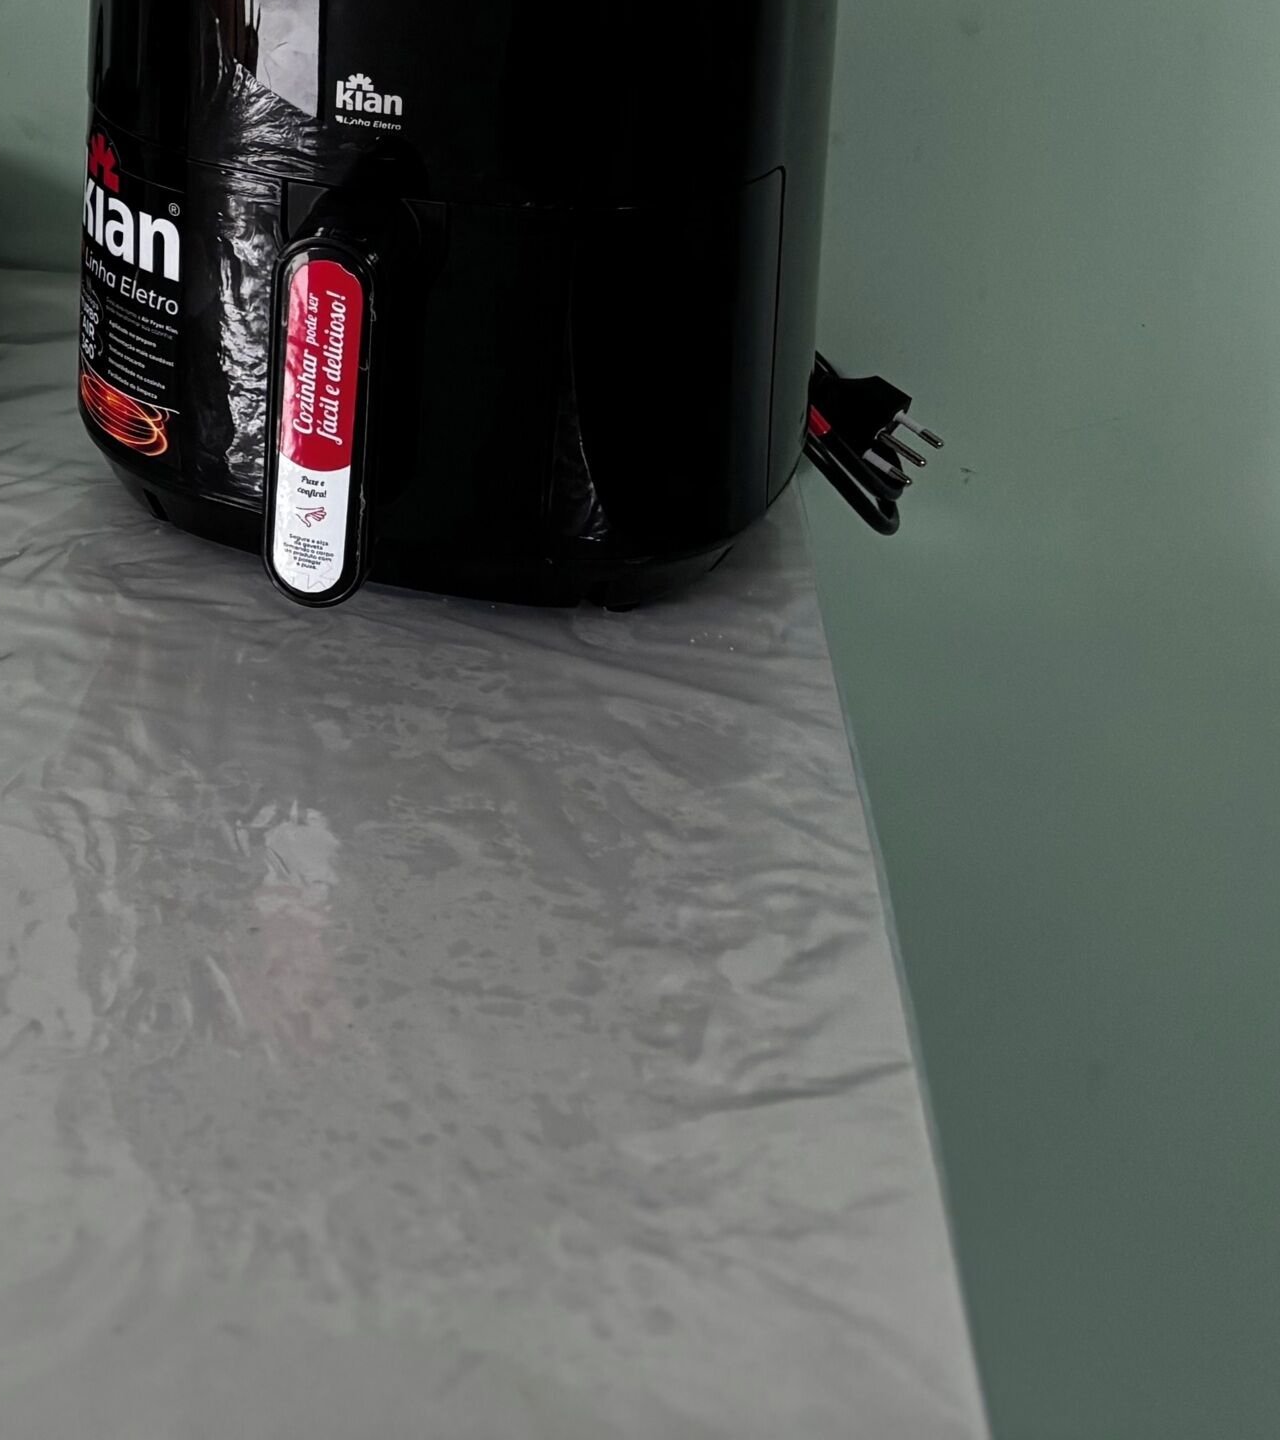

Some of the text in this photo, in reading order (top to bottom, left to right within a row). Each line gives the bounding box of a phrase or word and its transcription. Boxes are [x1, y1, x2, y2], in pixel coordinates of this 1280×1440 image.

[344, 117, 402, 131] Linha Eletro
[85, 247, 117, 288] Linha
[120, 276, 180, 316] Eletro
[292, 292, 320, 435] Cozinhar pode ser
[316, 290, 347, 446] fácil e delicioso!
[297, 486, 327, 499] confira!
